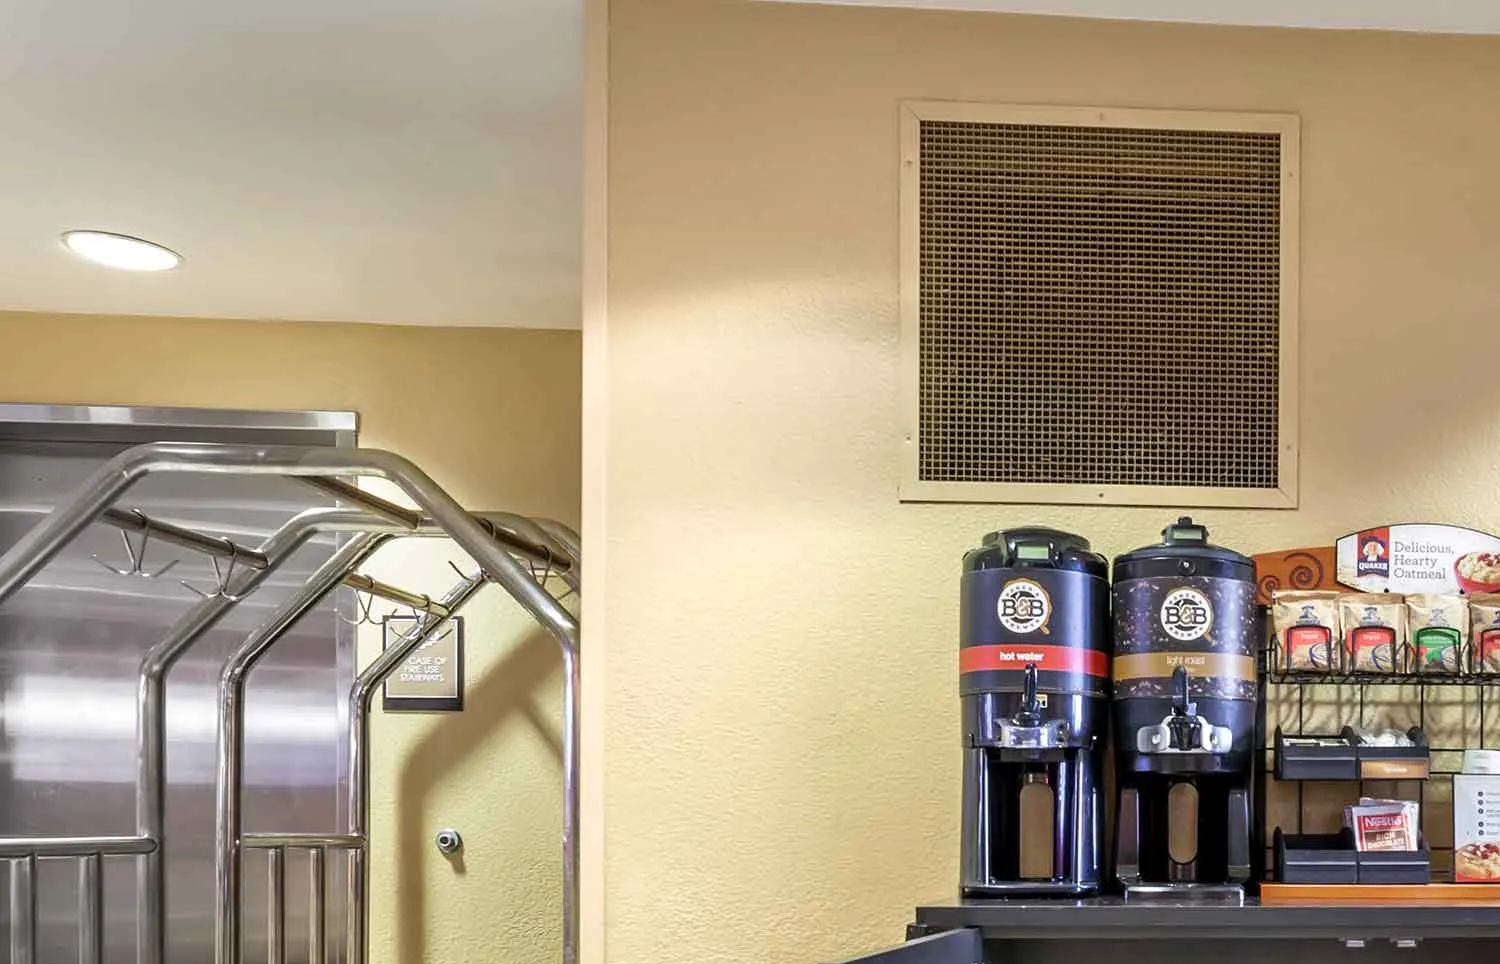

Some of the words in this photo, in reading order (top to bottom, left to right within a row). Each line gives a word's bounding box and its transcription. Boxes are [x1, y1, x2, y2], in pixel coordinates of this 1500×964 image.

[1394, 541, 1455, 554] Delicious,
[1359, 562, 1388, 571] QUAKER
[1394, 554, 1438, 568] Hearty
[1394, 567, 1446, 580] Oatmeal
[999, 651, 1015, 661] hot
[1016, 652, 1045, 661] water
